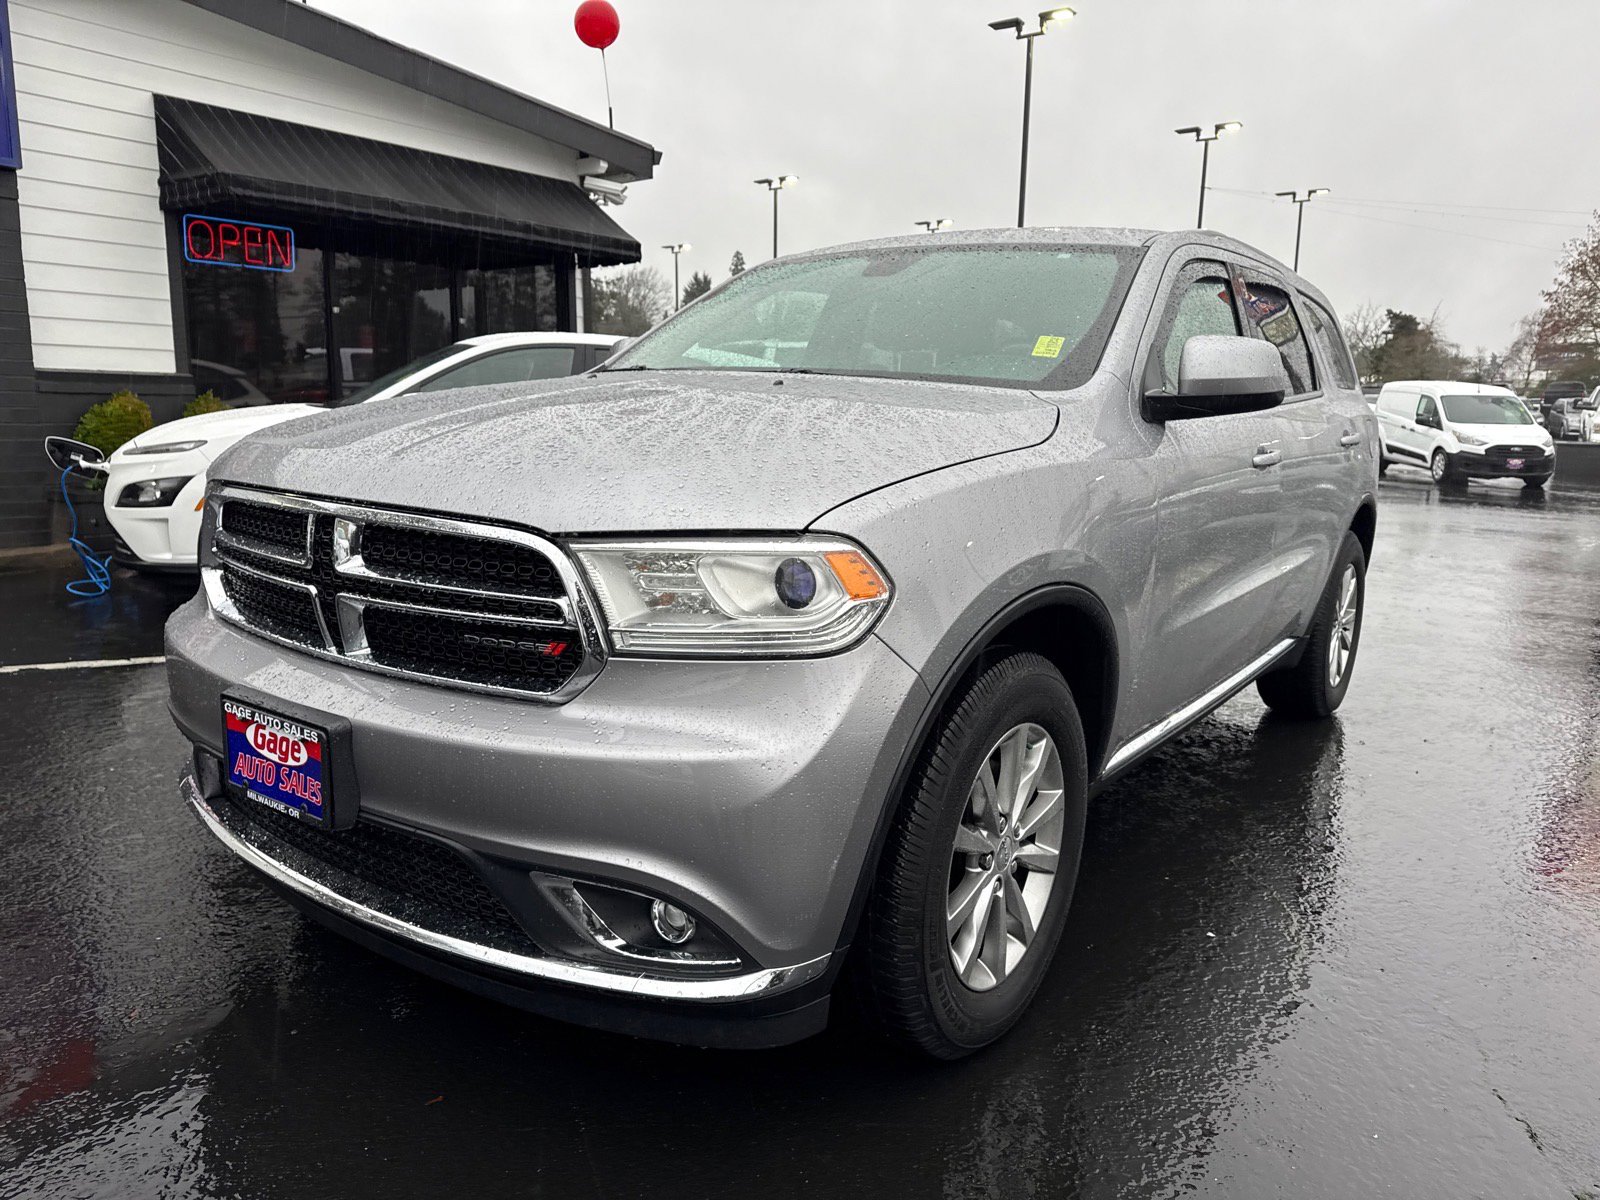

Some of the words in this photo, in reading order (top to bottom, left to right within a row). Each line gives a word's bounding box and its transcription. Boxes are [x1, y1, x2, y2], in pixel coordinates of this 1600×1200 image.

[188, 220, 291, 265] OPEN
[224, 702, 252, 720] GAGE
[254, 712, 282, 730] AUTO
[283, 722, 318, 743] SALES
[253, 724, 301, 763] Gage
[234, 752, 276, 786] AUTO
[279, 767, 322, 806] SALES
[288, 808, 300, 819] OR
